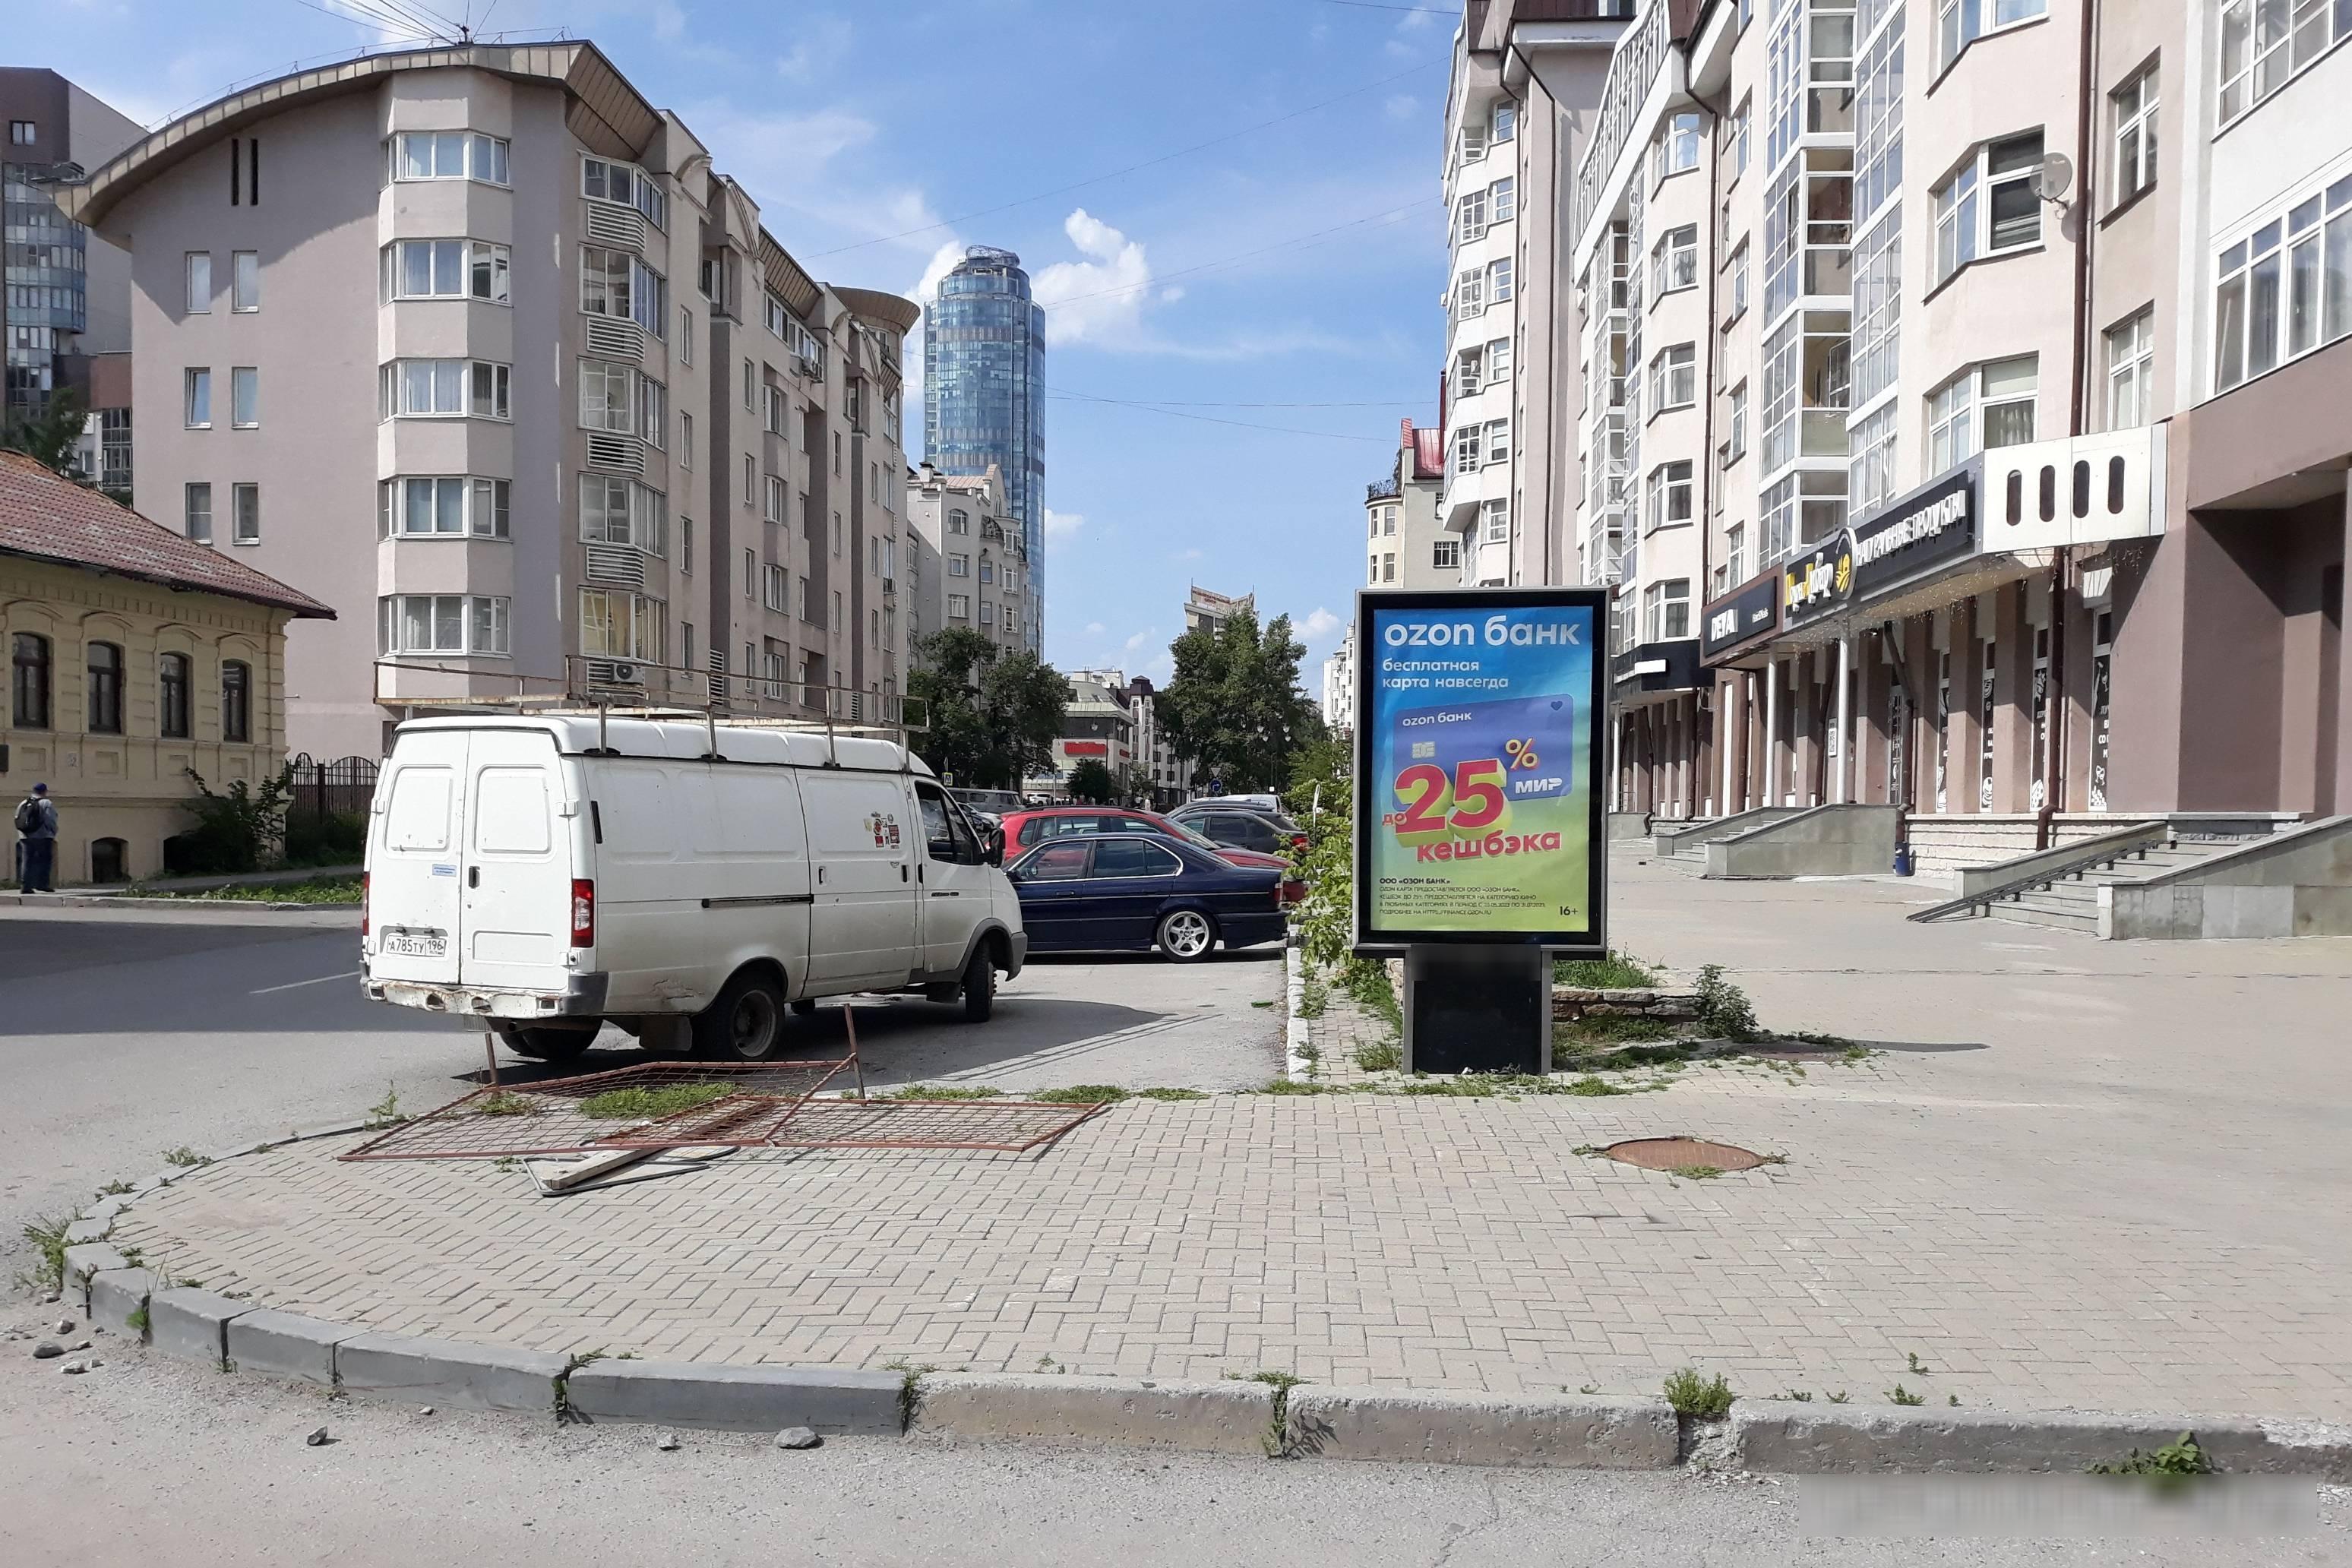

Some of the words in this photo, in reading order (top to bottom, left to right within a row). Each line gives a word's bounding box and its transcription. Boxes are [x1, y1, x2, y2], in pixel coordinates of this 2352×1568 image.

[1384, 623, 1475, 646] ozon
[1484, 615, 1581, 646] банк
[1382, 658, 1480, 672] бесплатная
[1383, 677, 1430, 691] карта
[1434, 676, 1510, 689] навсегда
[1402, 716, 1435, 727] ozon
[1437, 711, 1472, 723] банк
[1515, 777, 1563, 795] МИР
[1382, 812, 1408, 827] до
[1416, 830, 1561, 863] кешбэка
[1559, 906, 1579, 916] 16+
[427, 940, 444, 950] 196
